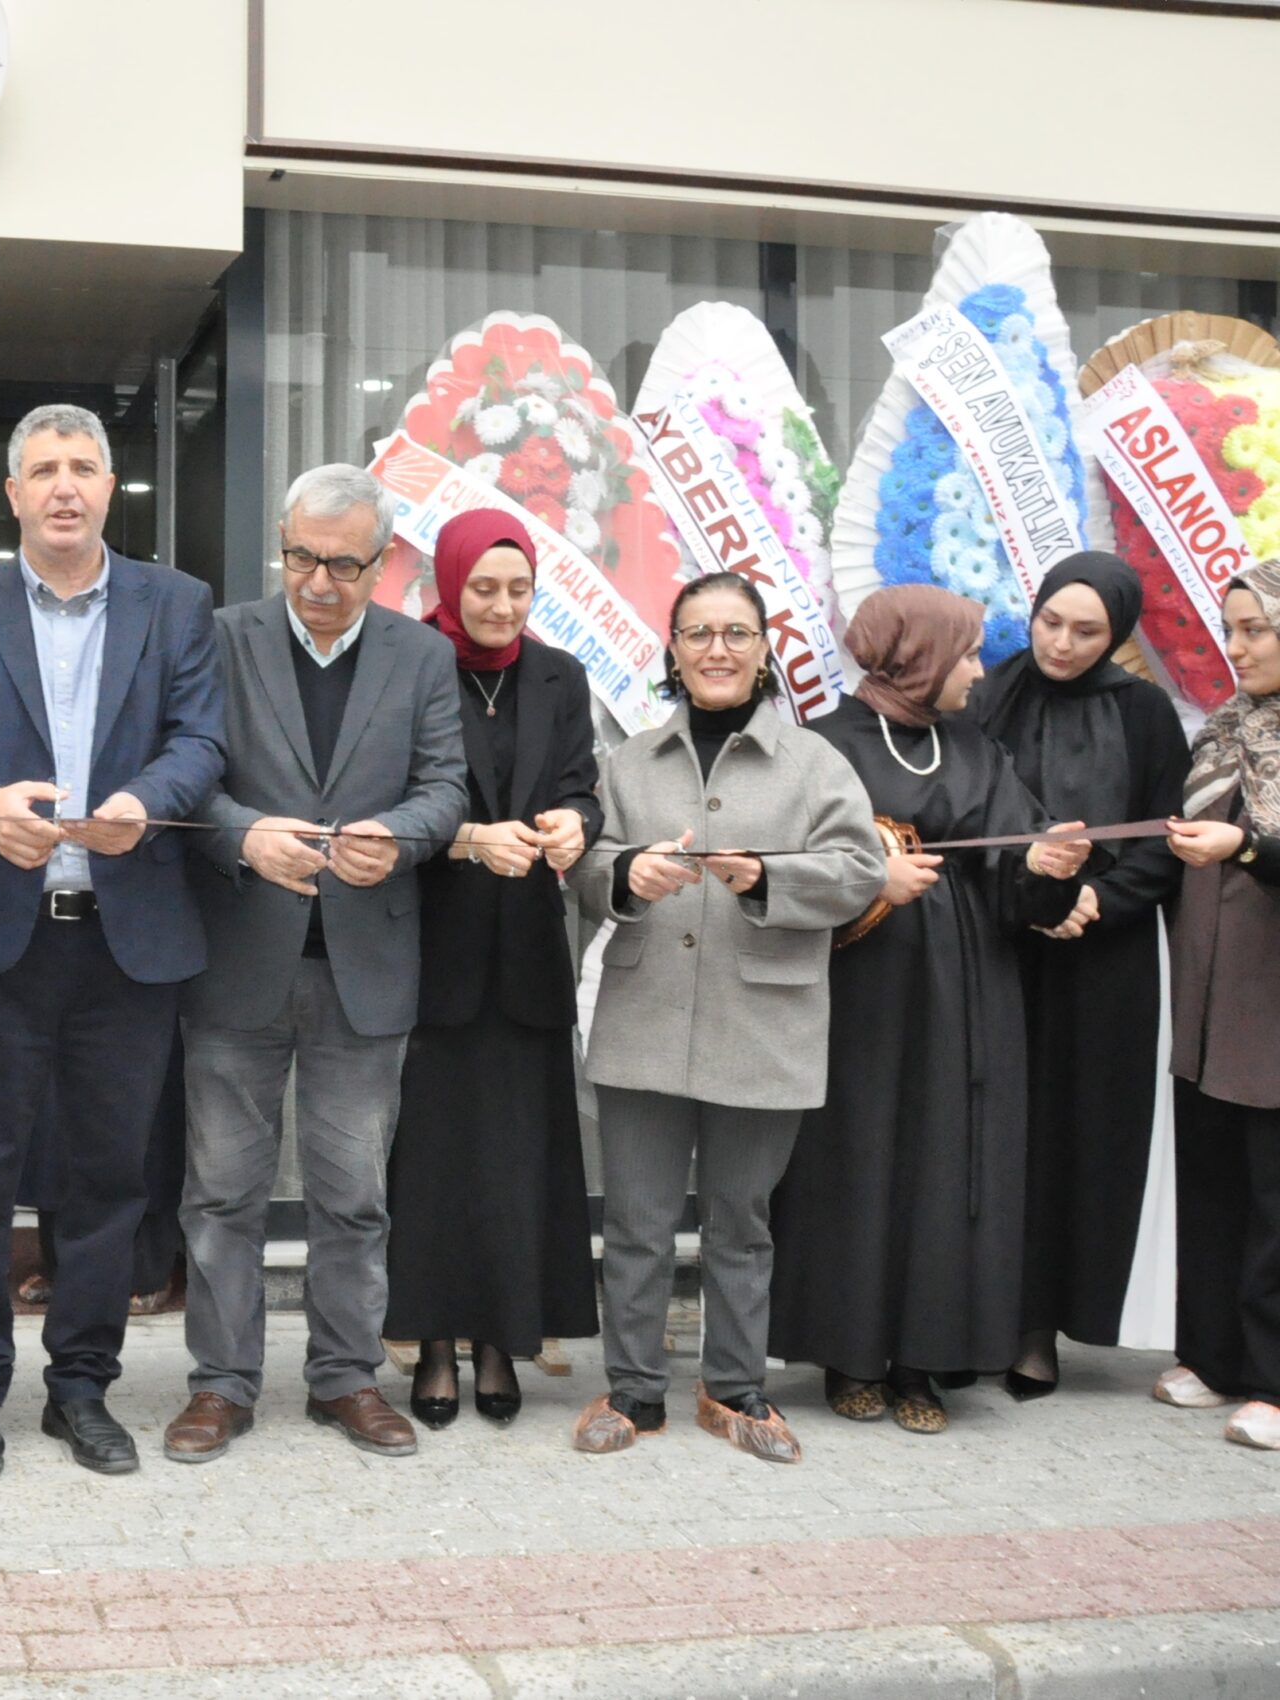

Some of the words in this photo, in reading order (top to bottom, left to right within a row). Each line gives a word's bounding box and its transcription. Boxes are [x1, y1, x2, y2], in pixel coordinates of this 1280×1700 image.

[965, 390, 1074, 565] AVUKATLIK
[549, 555, 602, 610] HALK
[593, 600, 660, 672] PARTİSİ
[637, 405, 777, 589] AYBERK
[767, 608, 827, 721] KUL
[575, 635, 631, 702] DEMİR
